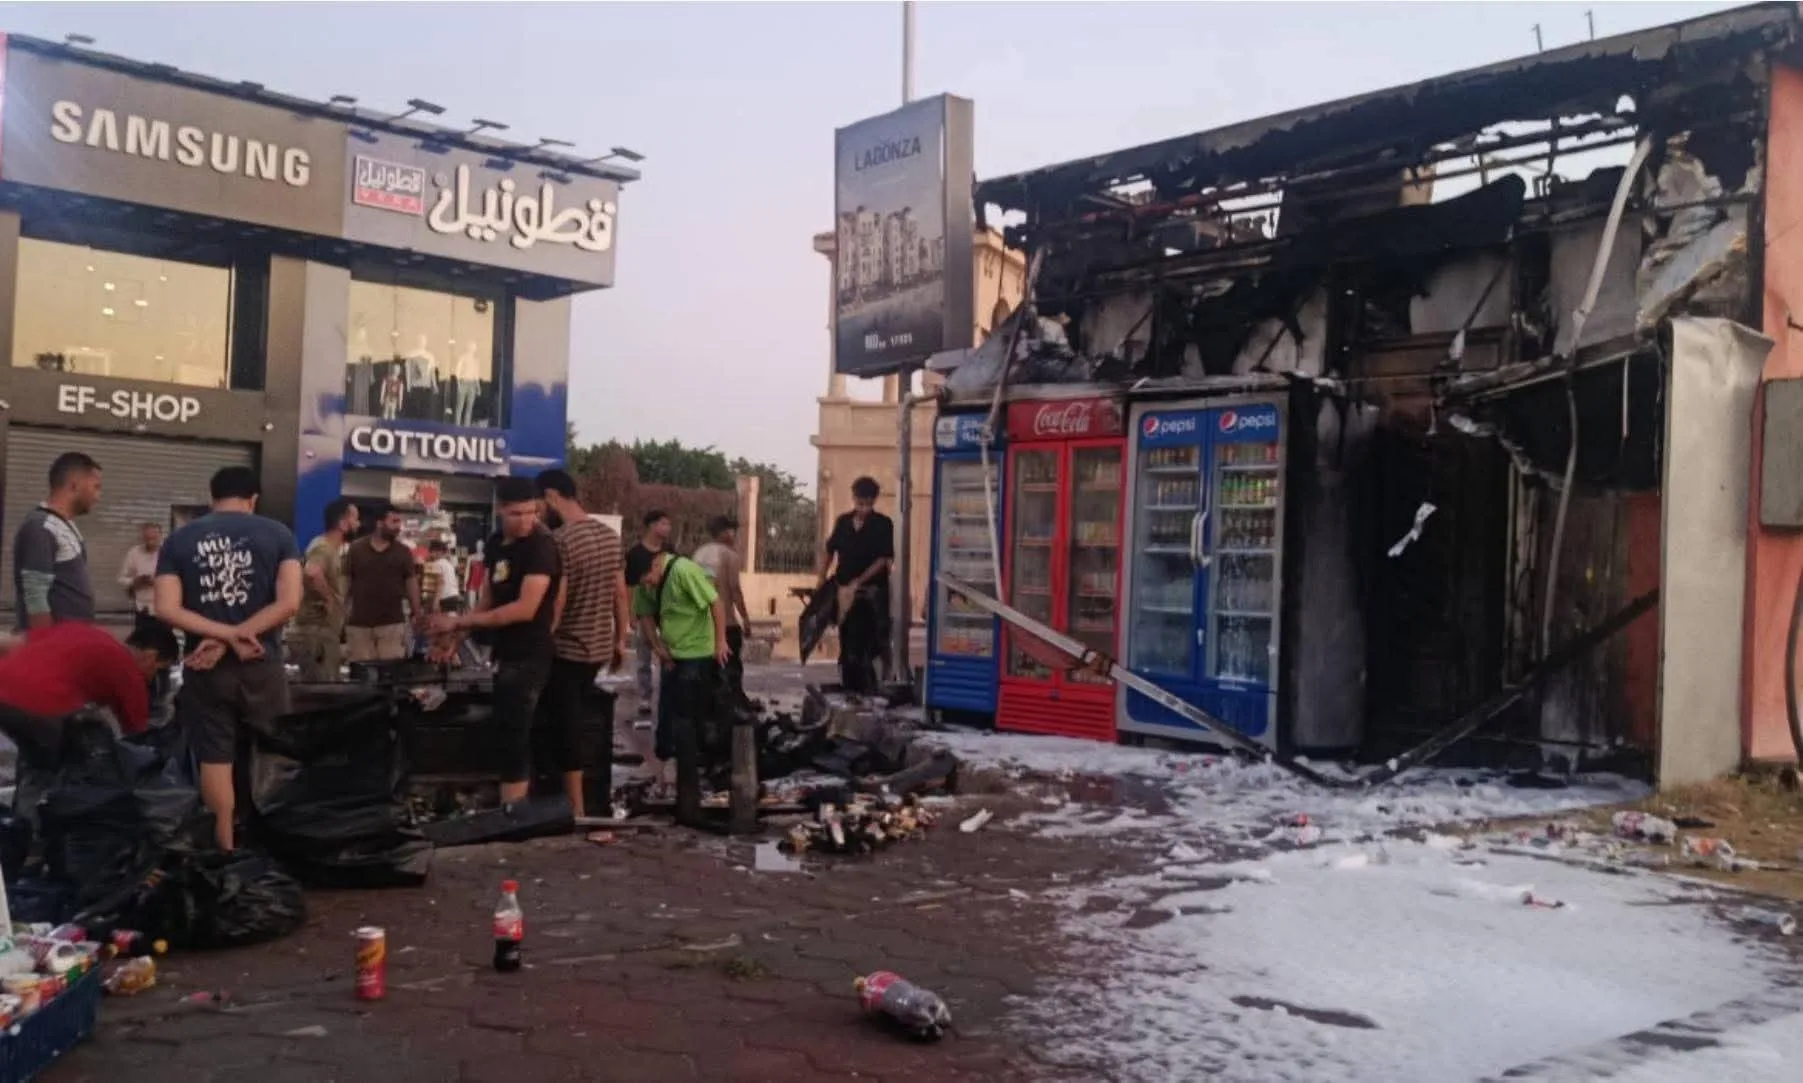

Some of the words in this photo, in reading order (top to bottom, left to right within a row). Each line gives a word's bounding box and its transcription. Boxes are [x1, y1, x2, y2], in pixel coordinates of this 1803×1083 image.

[50, 99, 311, 187] SAMSUNG
[428, 163, 616, 251] قطونيل
[58, 384, 201, 423] EF-SHOP
[1237, 412, 1276, 431] pepsi
[1160, 417, 1196, 435] pepsi
